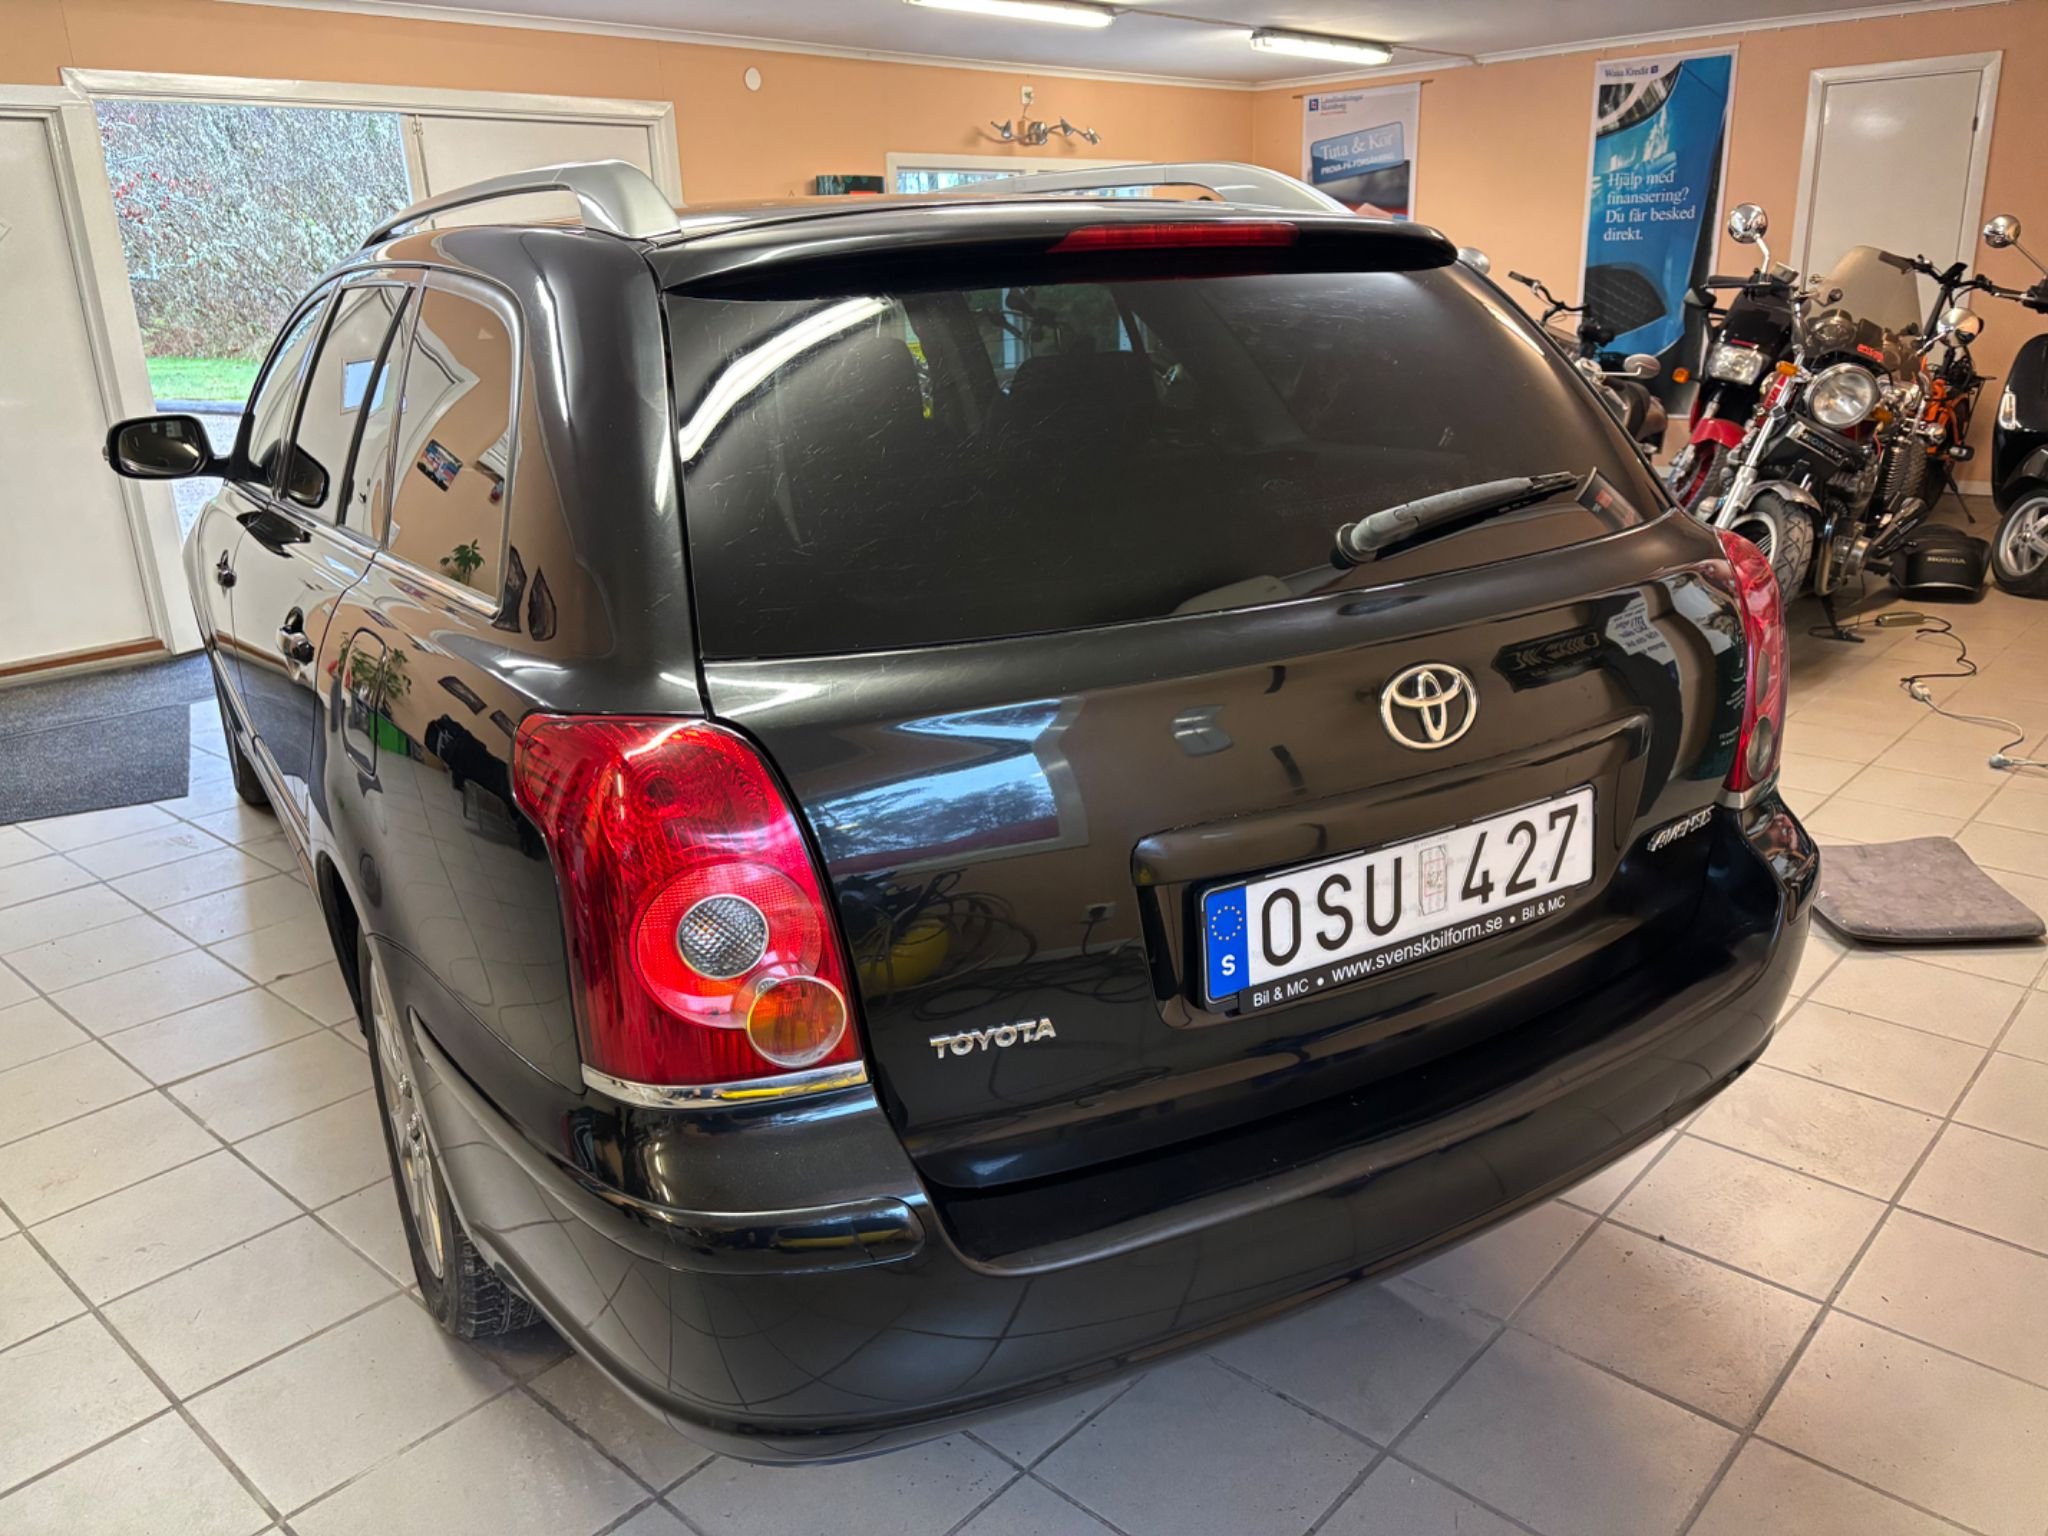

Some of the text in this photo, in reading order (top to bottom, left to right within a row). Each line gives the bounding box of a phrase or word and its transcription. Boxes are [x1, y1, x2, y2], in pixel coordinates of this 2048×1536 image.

[1351, 136, 1367, 154] &
[1608, 170, 1675, 190] Hjälp med
[1607, 187, 1690, 205] finansiering?
[1605, 205, 1696, 223] Du får besked
[1603, 227, 1643, 242] direkt.
[1261, 803, 1580, 967] OSU 427
[1252, 895, 1566, 1008] Bil & MC www.svenskbilform.se Bil & MC
[1220, 953, 1237, 977] S
[928, 1016, 1058, 1060] TOYOTA
